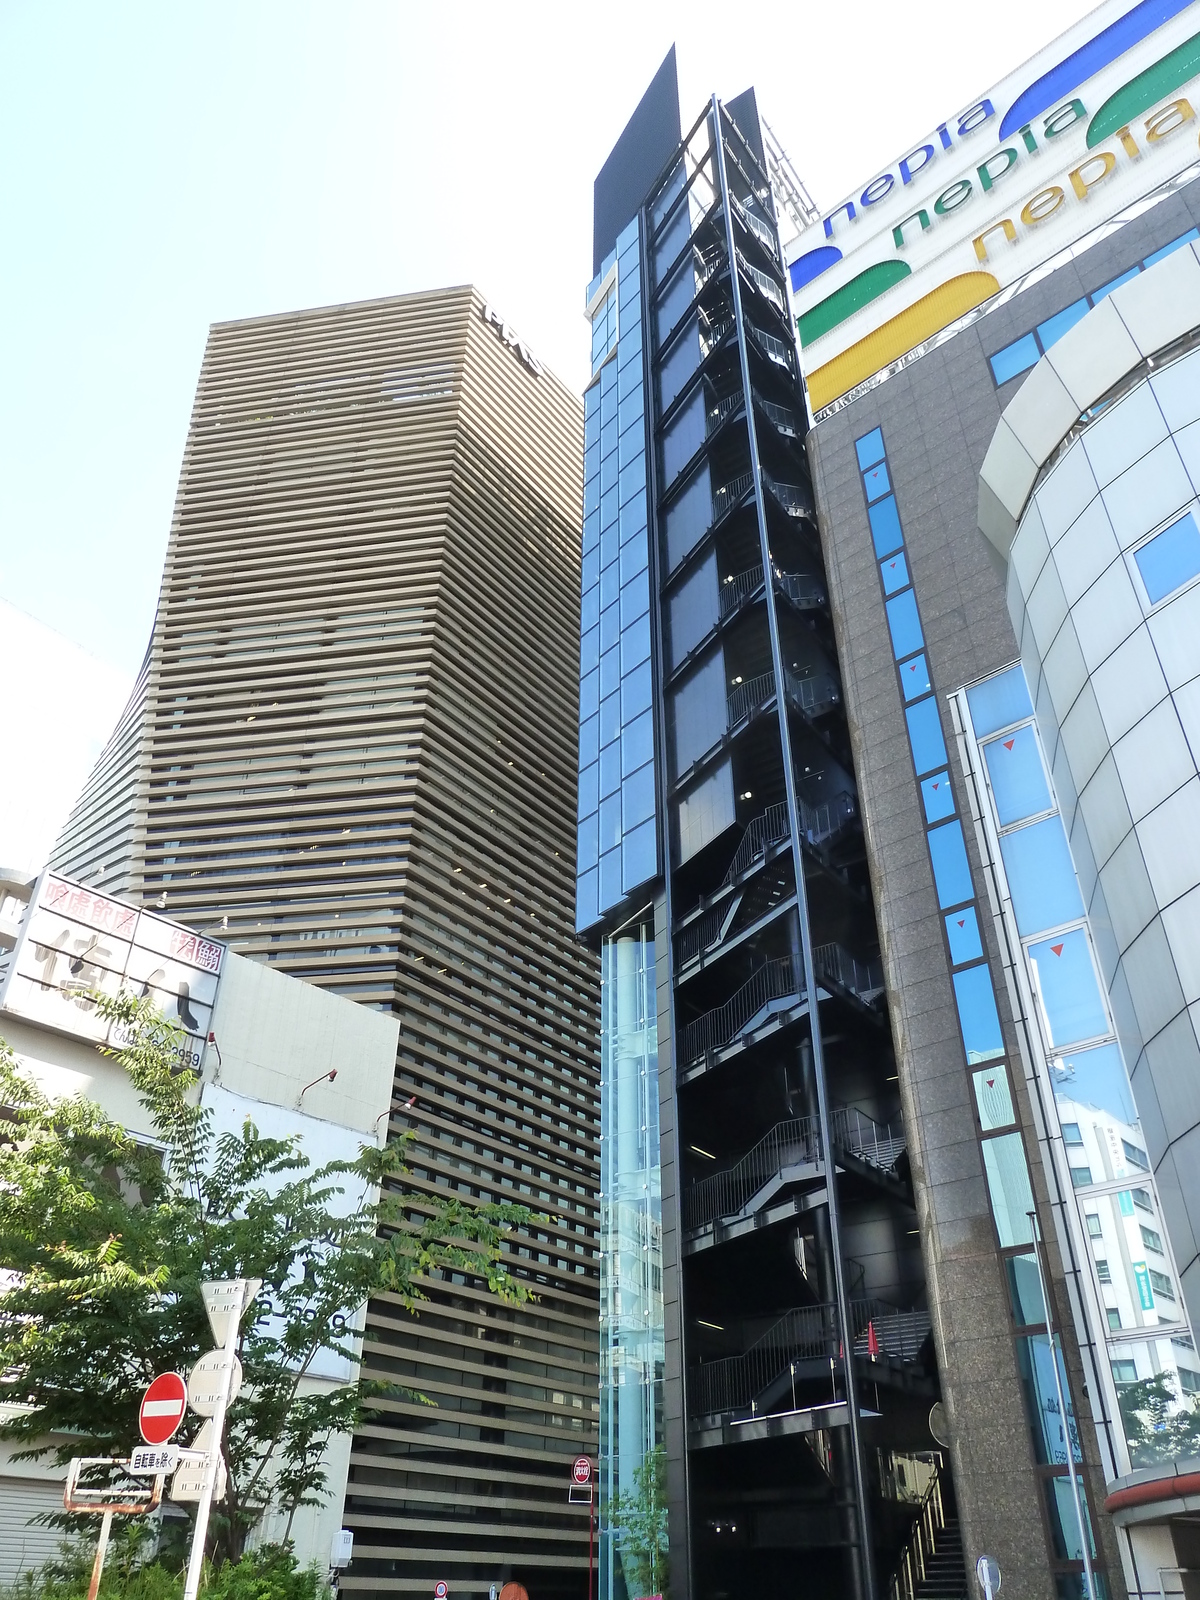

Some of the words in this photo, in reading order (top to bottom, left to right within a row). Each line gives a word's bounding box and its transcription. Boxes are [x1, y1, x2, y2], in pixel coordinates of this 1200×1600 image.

[823, 98, 995, 240] nepia
[892, 98, 1087, 250] nepia
[972, 97, 1196, 262] nepia
